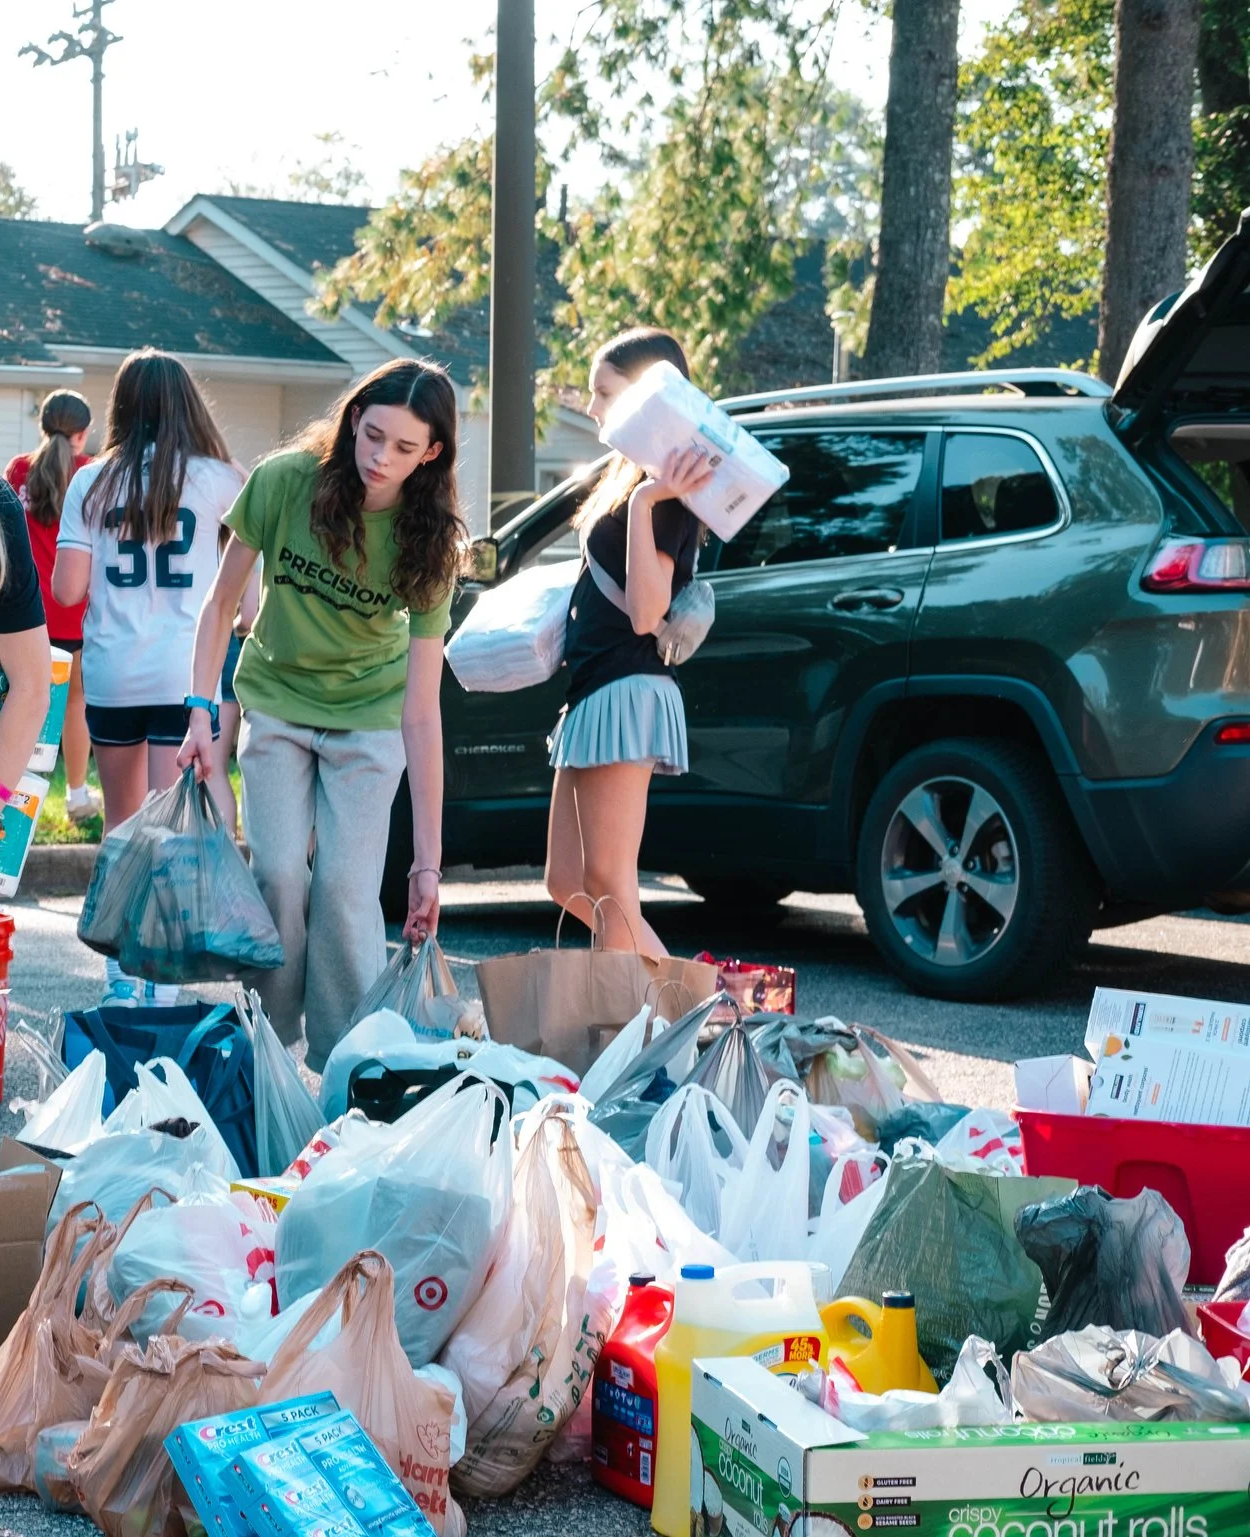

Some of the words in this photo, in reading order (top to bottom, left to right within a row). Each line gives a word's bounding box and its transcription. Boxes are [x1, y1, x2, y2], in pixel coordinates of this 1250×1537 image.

[105, 508, 196, 588] 32
[278, 547, 391, 606] PRECISION
[454, 744, 526, 755] CHEROKEE
[199, 1415, 256, 1441] Crest
[281, 1413, 288, 1423] 5
[291, 1405, 320, 1420] PACK
[207, 1439, 227, 1451] PRO
[227, 1431, 262, 1446] HEALTH
[725, 1417, 758, 1464] Organic
[257, 1441, 299, 1466] Crest
[314, 1436, 322, 1445] 5
[322, 1425, 343, 1442] PACK
[320, 1456, 340, 1470] PRO
[718, 1452, 764, 1510] coconut
[1020, 1460, 1140, 1520] Organic
[948, 1503, 1004, 1524] crispy
[1129, 1506, 1209, 1537] rolls
